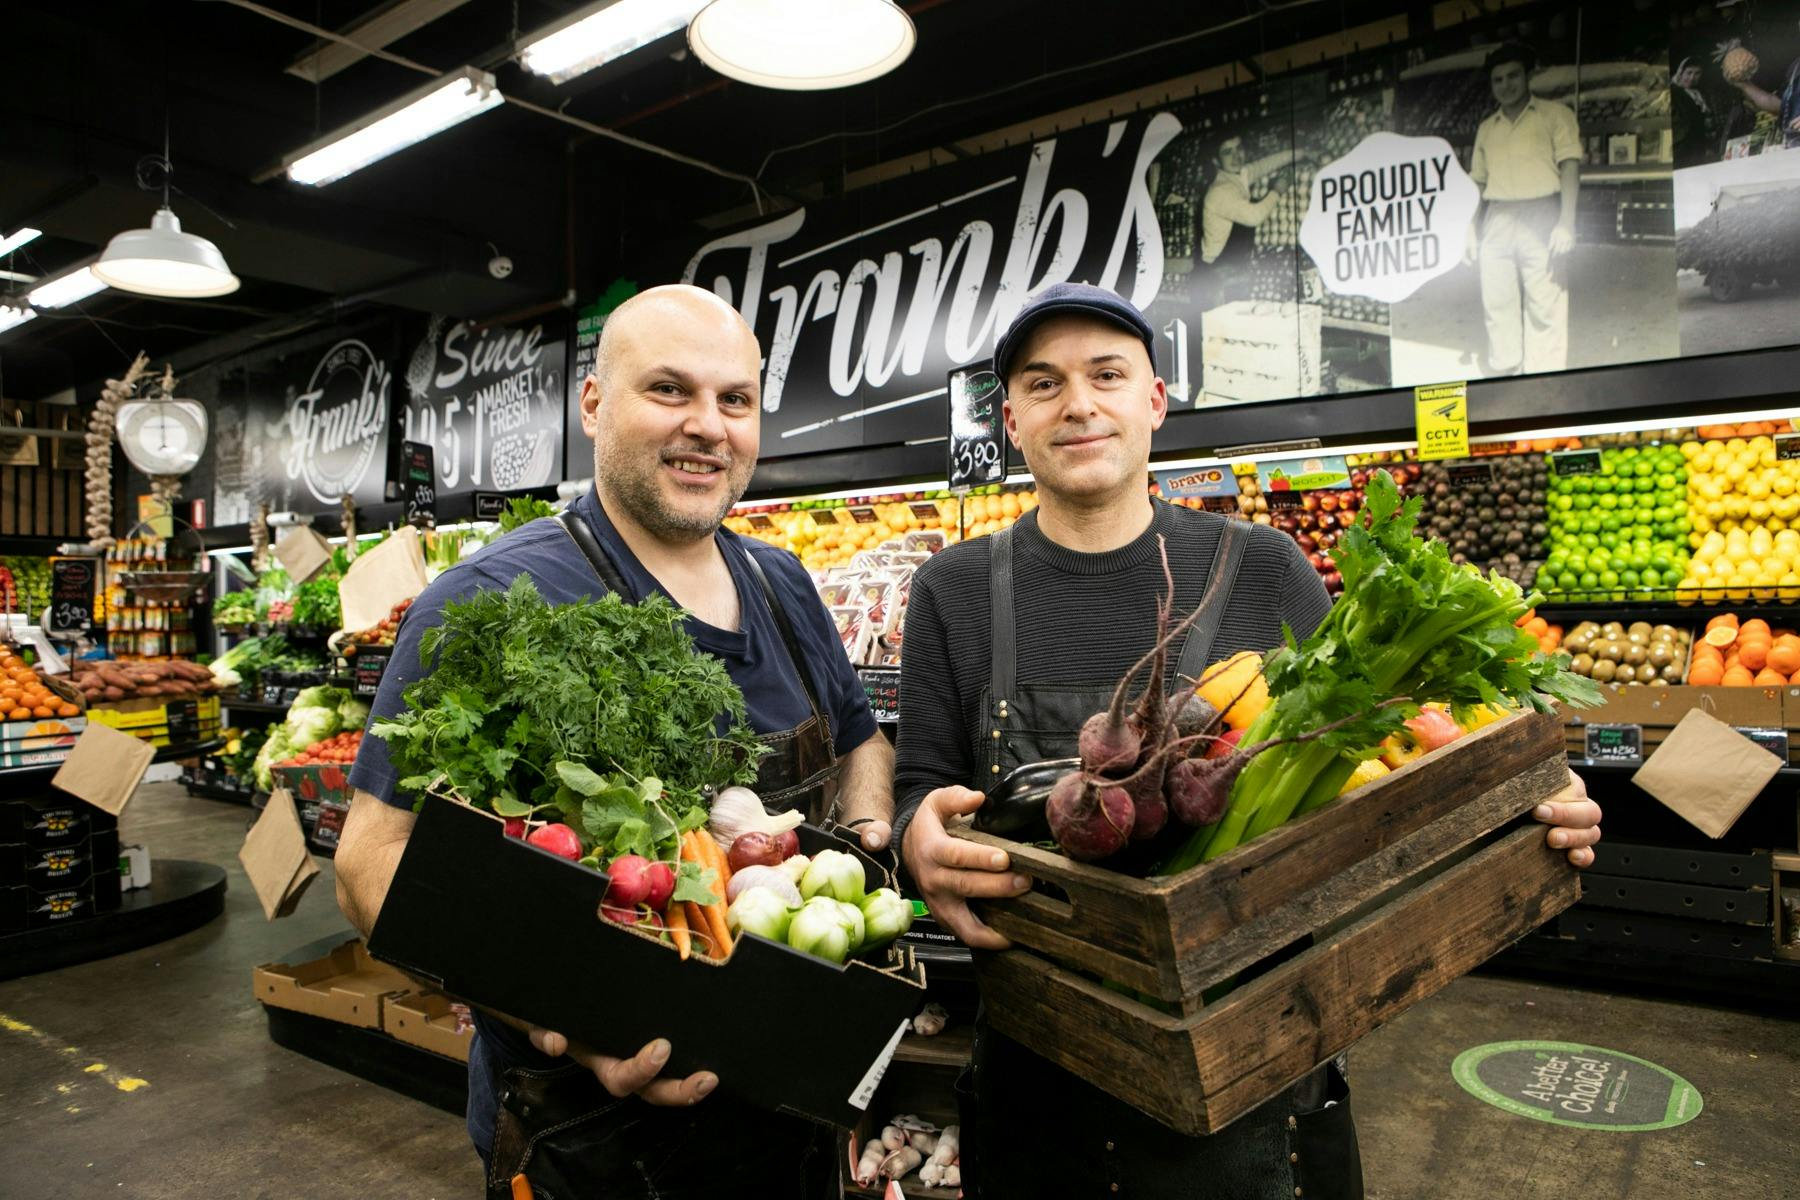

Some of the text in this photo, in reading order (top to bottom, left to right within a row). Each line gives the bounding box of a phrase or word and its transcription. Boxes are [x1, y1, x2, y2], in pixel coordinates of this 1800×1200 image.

[1321, 154, 1450, 212] PROUDLY
[1337, 196, 1436, 246] FAMILY
[680, 112, 1183, 413] Frank's
[1335, 233, 1440, 282] OWNED
[435, 319, 544, 389] Since
[483, 367, 534, 413] MARKET
[286, 360, 392, 479] Frank's
[489, 397, 530, 437] FRESH
[1425, 428, 1460, 441] CCTV
[1169, 470, 1223, 491] bravo
[926, 932, 956, 941] TOMATOES
[1521, 1088, 1550, 1103] A
